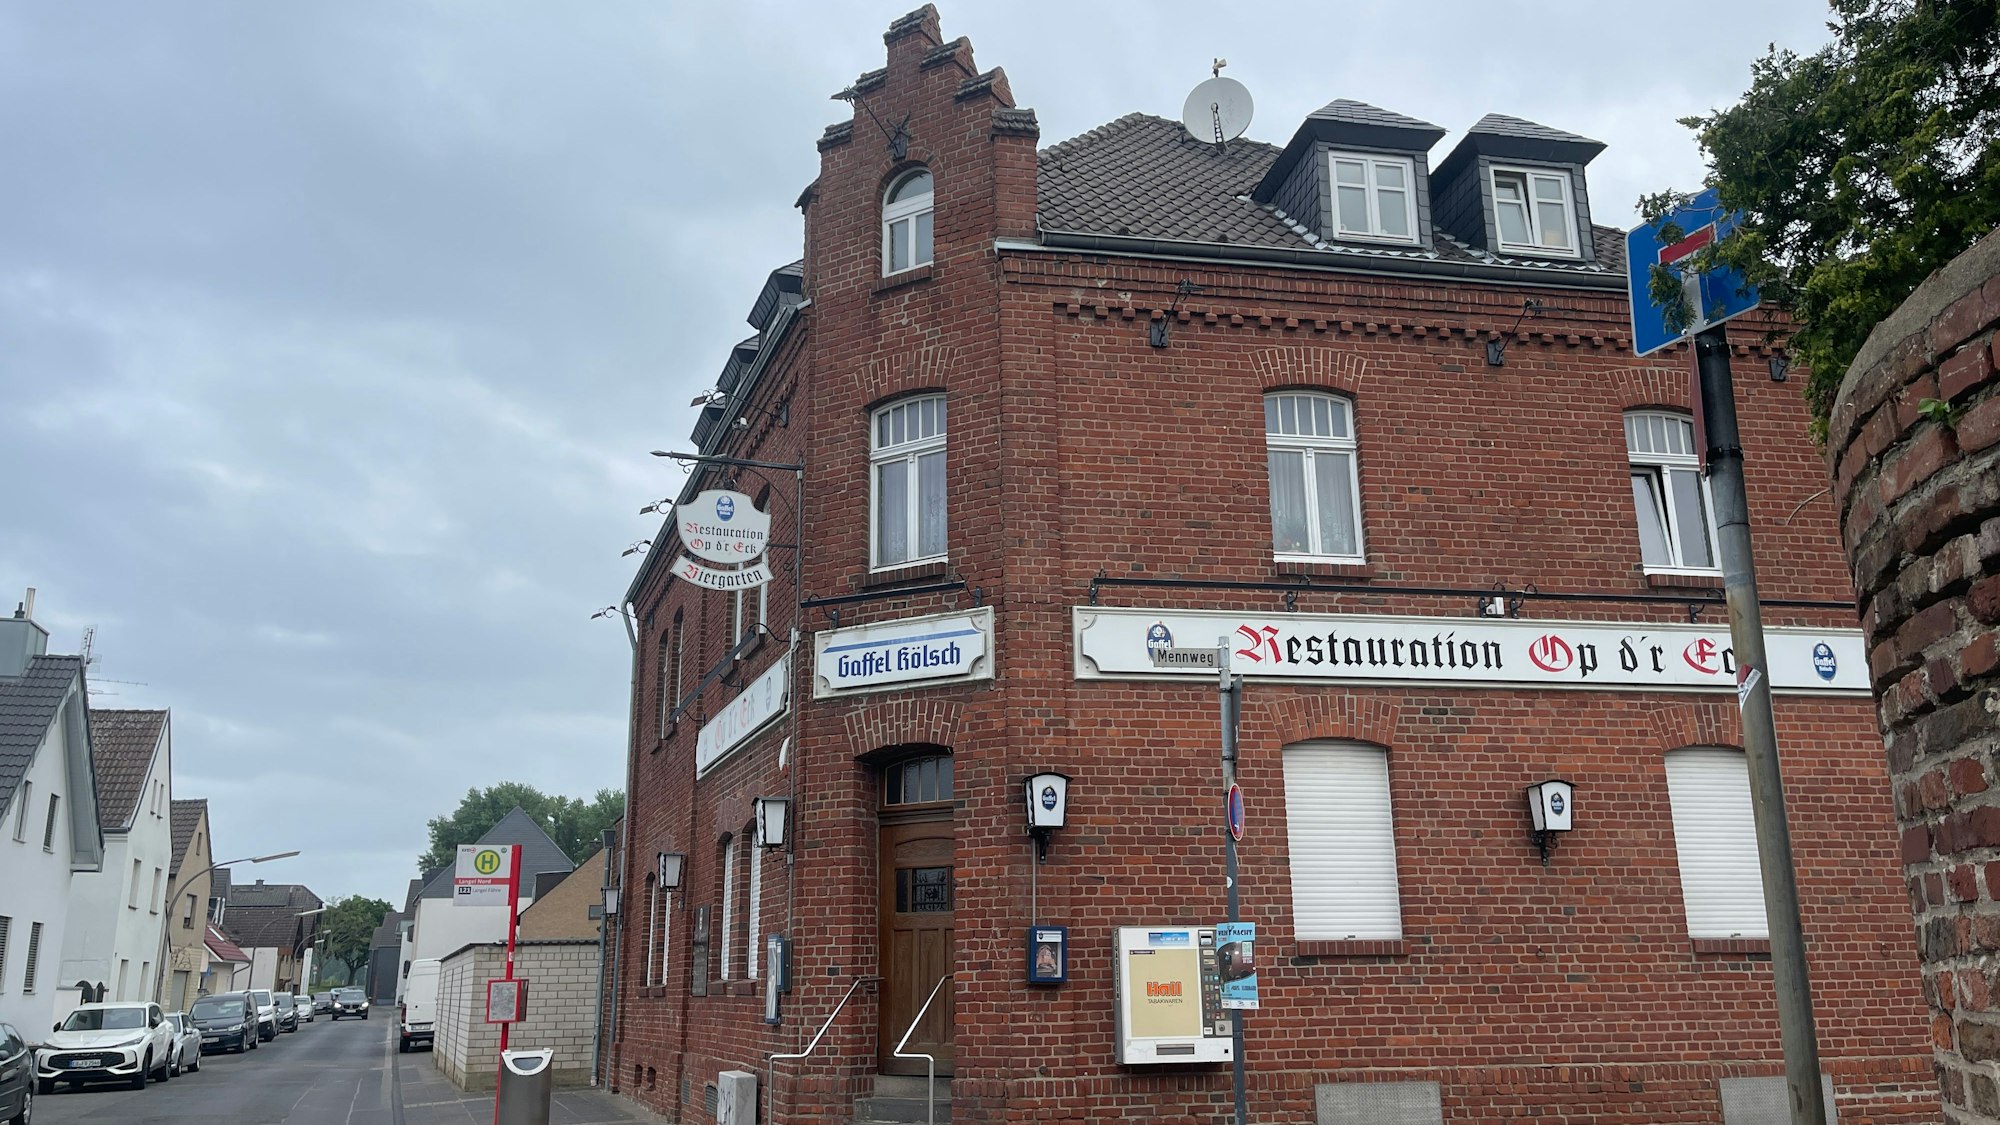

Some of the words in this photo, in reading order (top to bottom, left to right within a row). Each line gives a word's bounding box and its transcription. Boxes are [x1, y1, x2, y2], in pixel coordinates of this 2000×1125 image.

[685, 522, 763, 540] Restauration
[690, 538, 711, 551] Op
[733, 541, 757, 554] Eck
[683, 564, 763, 588] Biergarten
[1147, 638, 1172, 650] Gaffel
[1234, 623, 1503, 671] Restauration
[1528, 633, 1598, 678] Op
[1682, 636, 1736, 676] Ec
[838, 649, 892, 678] Gaffel
[897, 641, 961, 671] Kölsch
[1157, 649, 1214, 667] Mennweg
[1814, 656, 1835, 667] Gaffel
[481, 854, 495, 870] H
[458, 878, 477, 886] Langel
[1146, 981, 1182, 997] Hall
